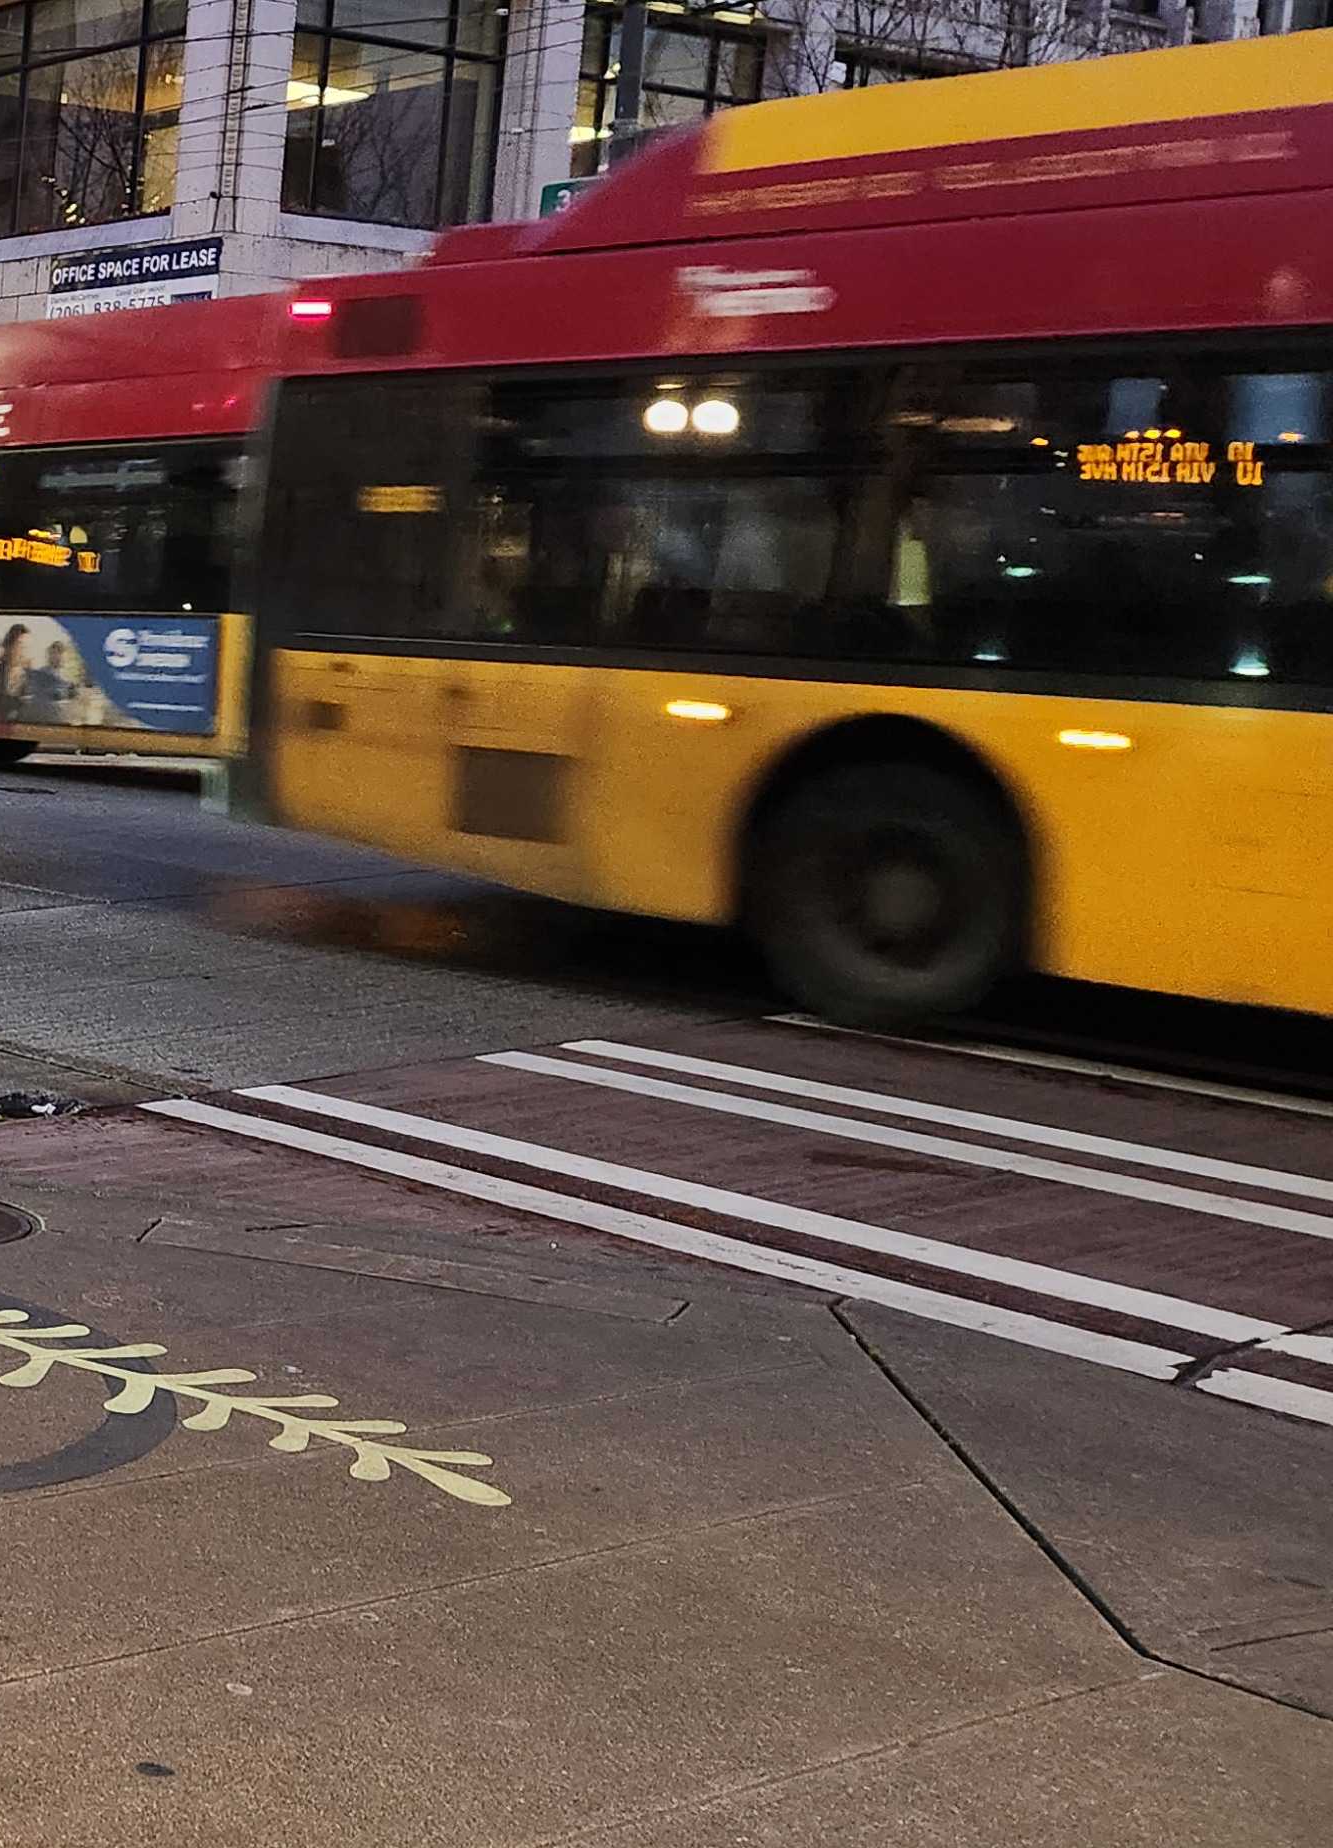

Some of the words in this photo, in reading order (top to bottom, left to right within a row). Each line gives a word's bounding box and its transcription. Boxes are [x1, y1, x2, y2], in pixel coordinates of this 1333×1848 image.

[52, 264, 96, 285] OFFICE
[97, 258, 140, 280] SPACE
[142, 252, 170, 274] FOR
[171, 247, 217, 270] LEASE
